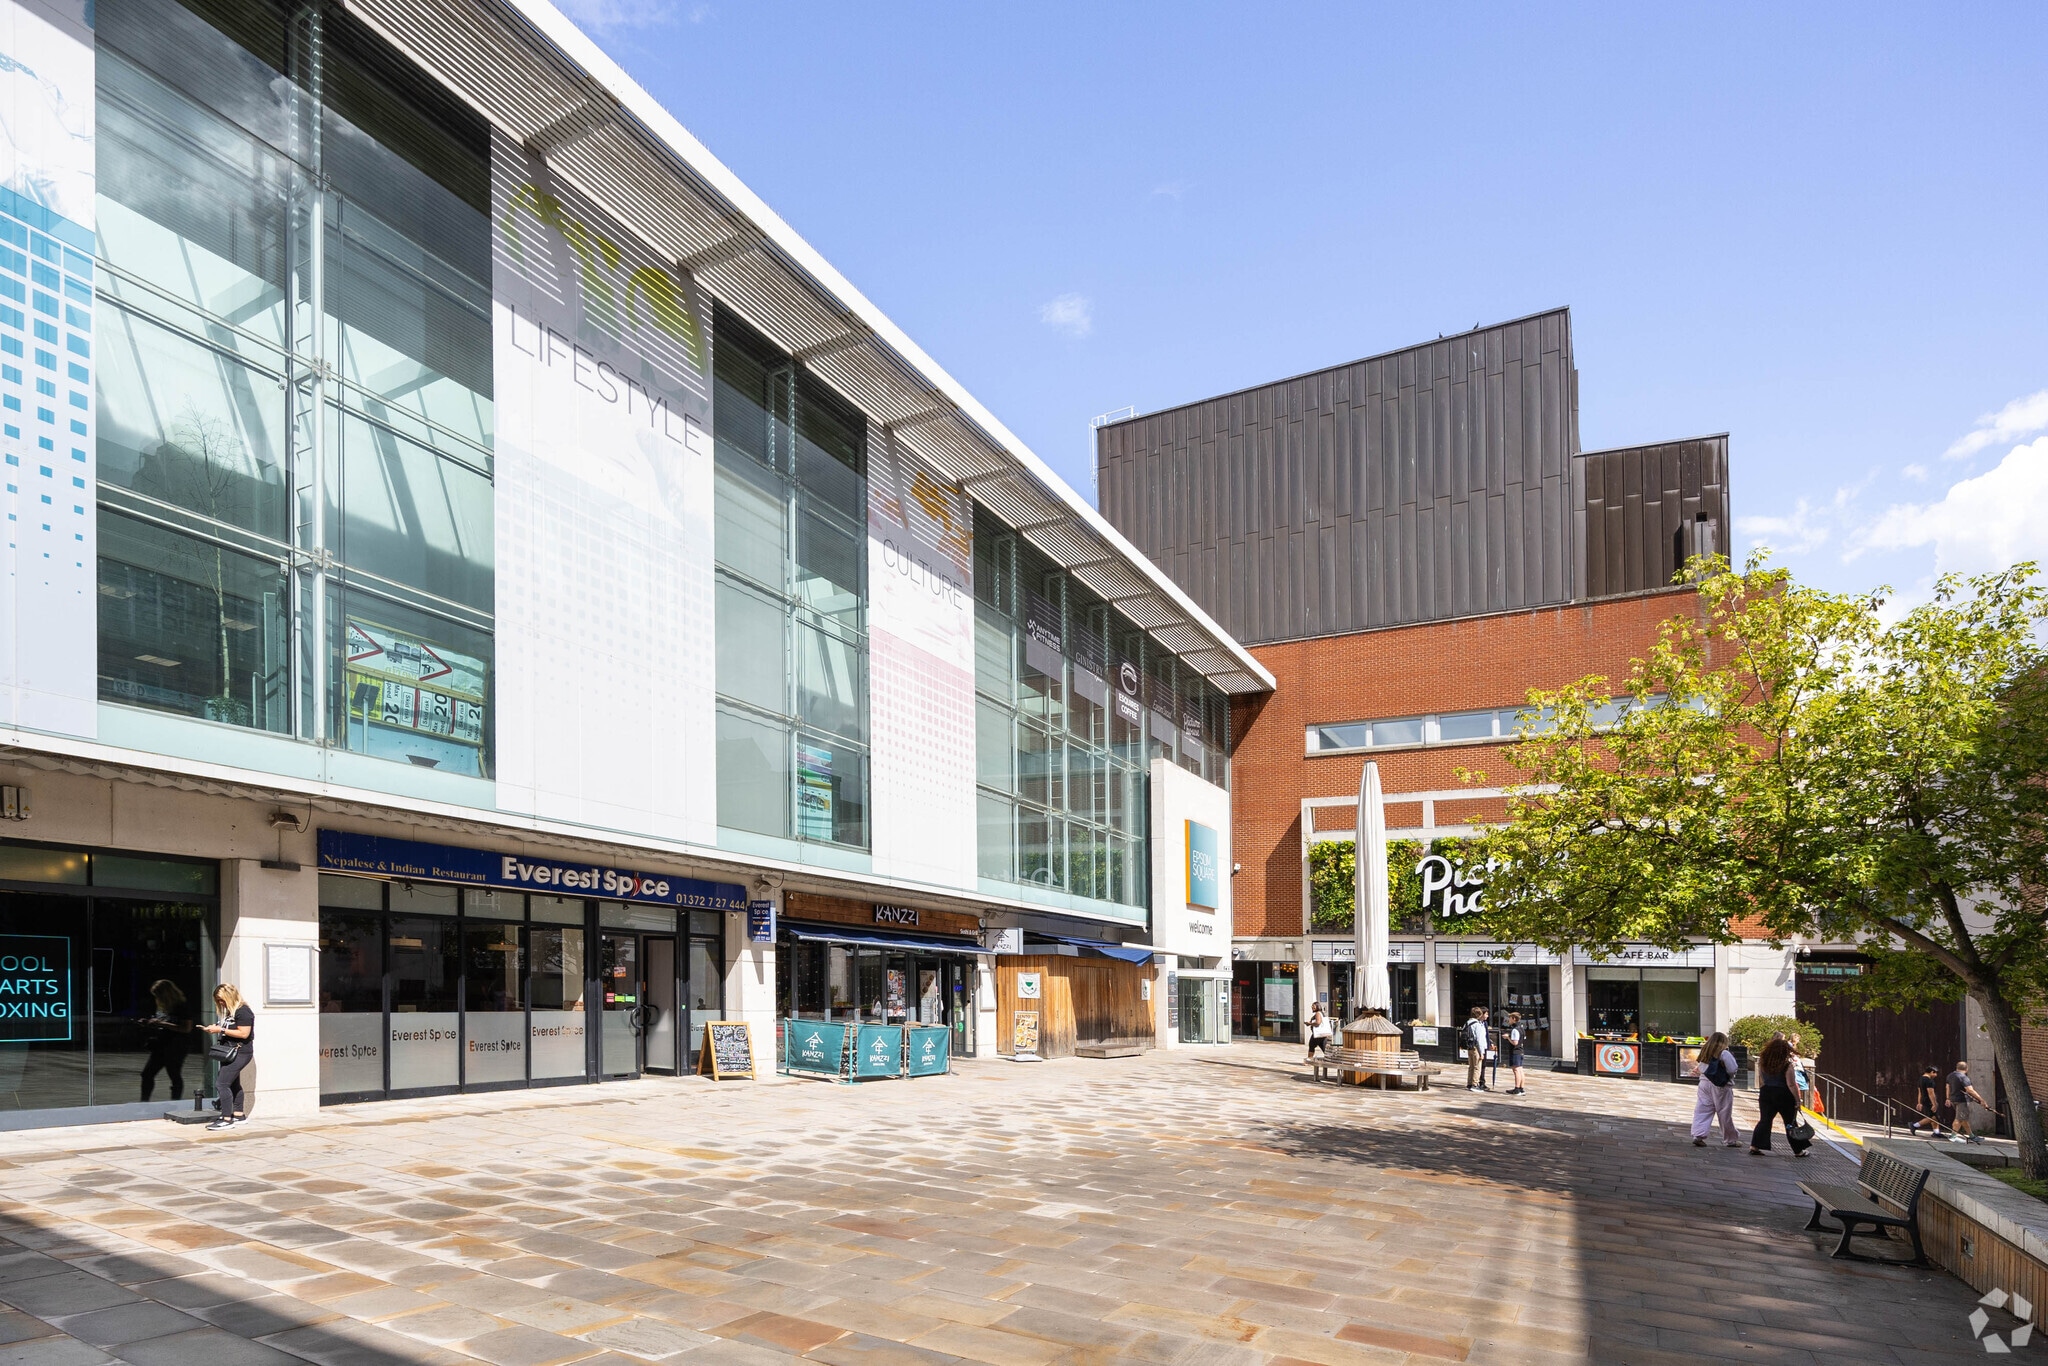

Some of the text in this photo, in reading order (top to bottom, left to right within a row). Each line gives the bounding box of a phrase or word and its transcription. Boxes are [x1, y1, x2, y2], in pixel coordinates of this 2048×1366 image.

[511, 303, 702, 456] LIFESTYLE
[883, 538, 964, 611] CULTURE
[1036, 625, 1061, 645] ANYTIME
[1036, 632, 1061, 652] FITNESS
[1075, 652, 1103, 677] GINISTRY
[116, 681, 146, 697] READ
[402, 694, 411, 721] Skid risk
[434, 693, 448, 717] 20
[1118, 692, 1140, 712] ESQUIRES
[422, 711, 430, 725] Skid
[1121, 704, 1138, 721] COFFEE
[1192, 850, 1212, 866] EPSOM
[324, 854, 487, 882] Nepalese & Indian Restaurant
[1192, 864, 1215, 882] SQUARE
[501, 856, 600, 890] Everest
[603, 869, 670, 898] Spice
[676, 893, 706, 906] 01372
[729, 899, 745, 910] 444
[875, 904, 919, 926] KANZZI
[1189, 920, 1213, 936] welcome
[0, 955, 54, 972] OOL
[0, 979, 59, 995] ARTS
[0, 1002, 67, 1018] OXING
[392, 1029, 427, 1041] Everest
[532, 1025, 560, 1037] Everest
[319, 1046, 349, 1058] verest
[469, 1040, 499, 1052] Everest
[801, 1049, 825, 1058] KANZZI
[869, 1054, 890, 1063] KANZZI
[921, 1054, 936, 1062] KANZZI
[1612, 1052, 1622, 1063] 3
